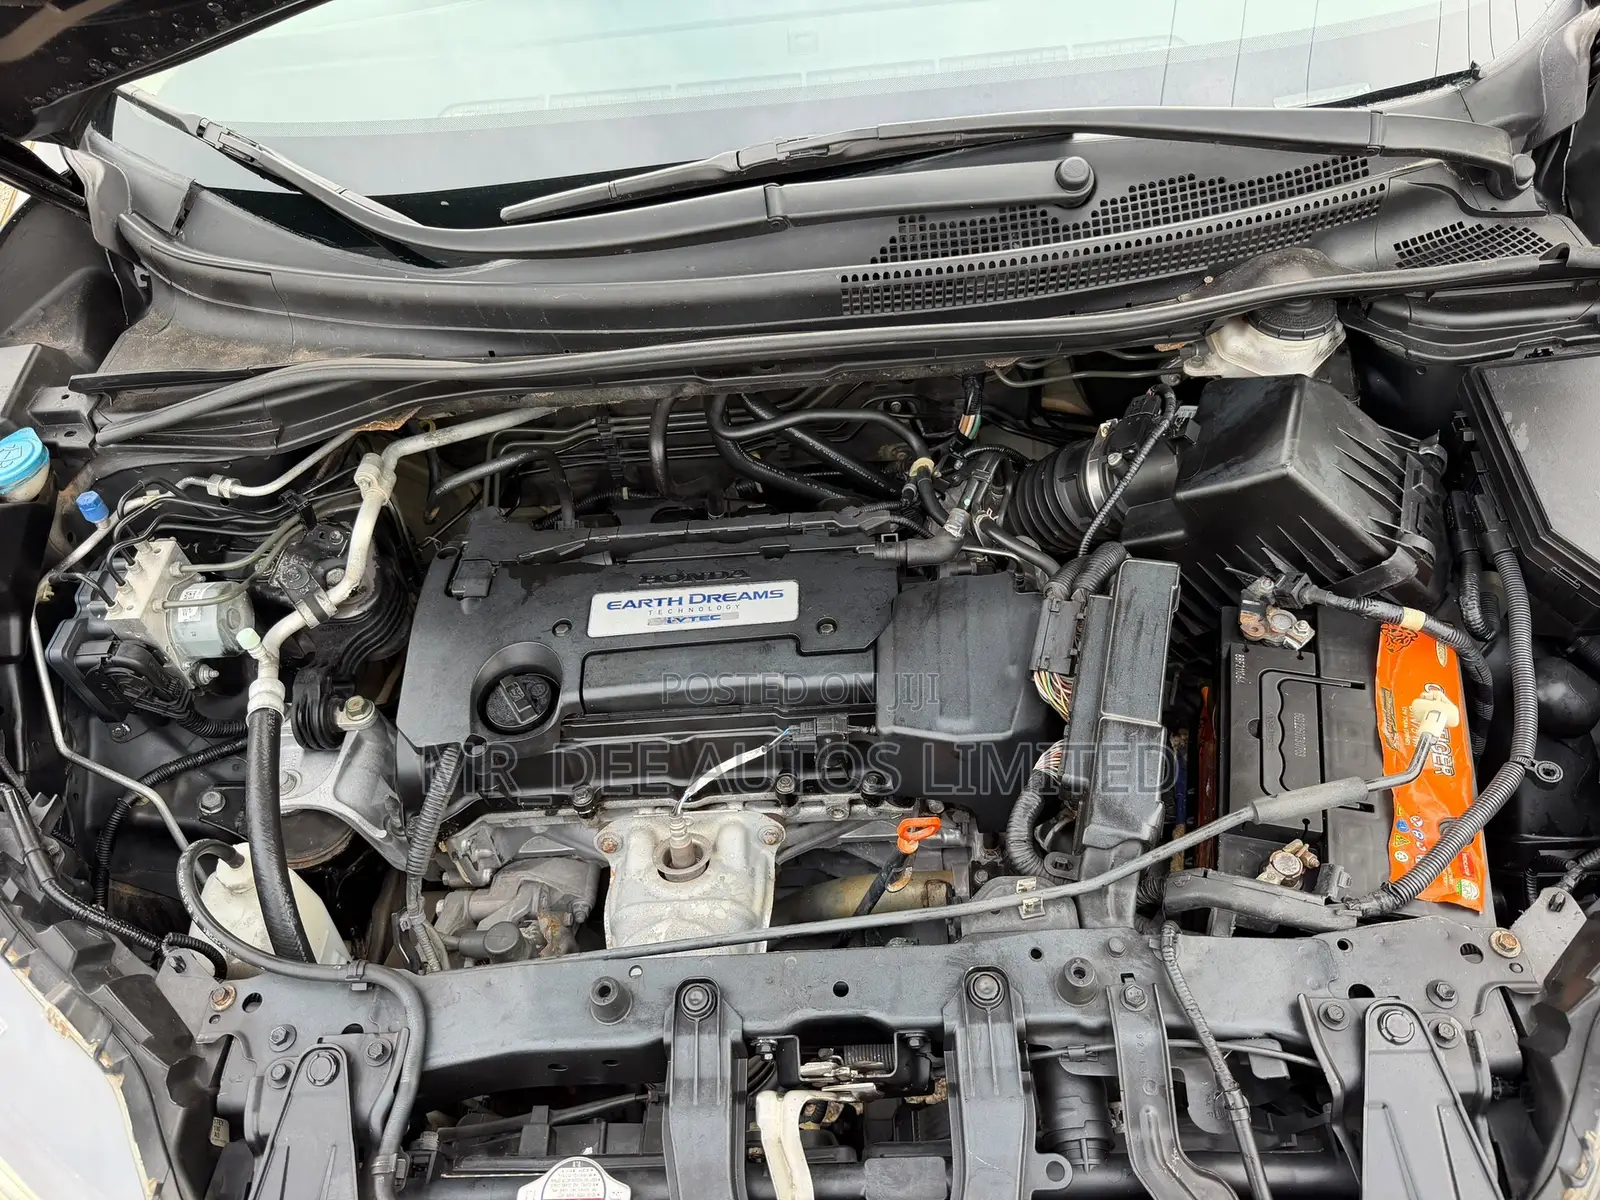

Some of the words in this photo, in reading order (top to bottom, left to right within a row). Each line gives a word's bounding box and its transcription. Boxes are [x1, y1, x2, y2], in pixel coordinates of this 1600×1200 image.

[638, 569, 751, 586] HONDA
[606, 595, 684, 611] EARTH
[688, 589, 784, 605] DREAMS
[649, 604, 740, 616] TECHNOLOGY
